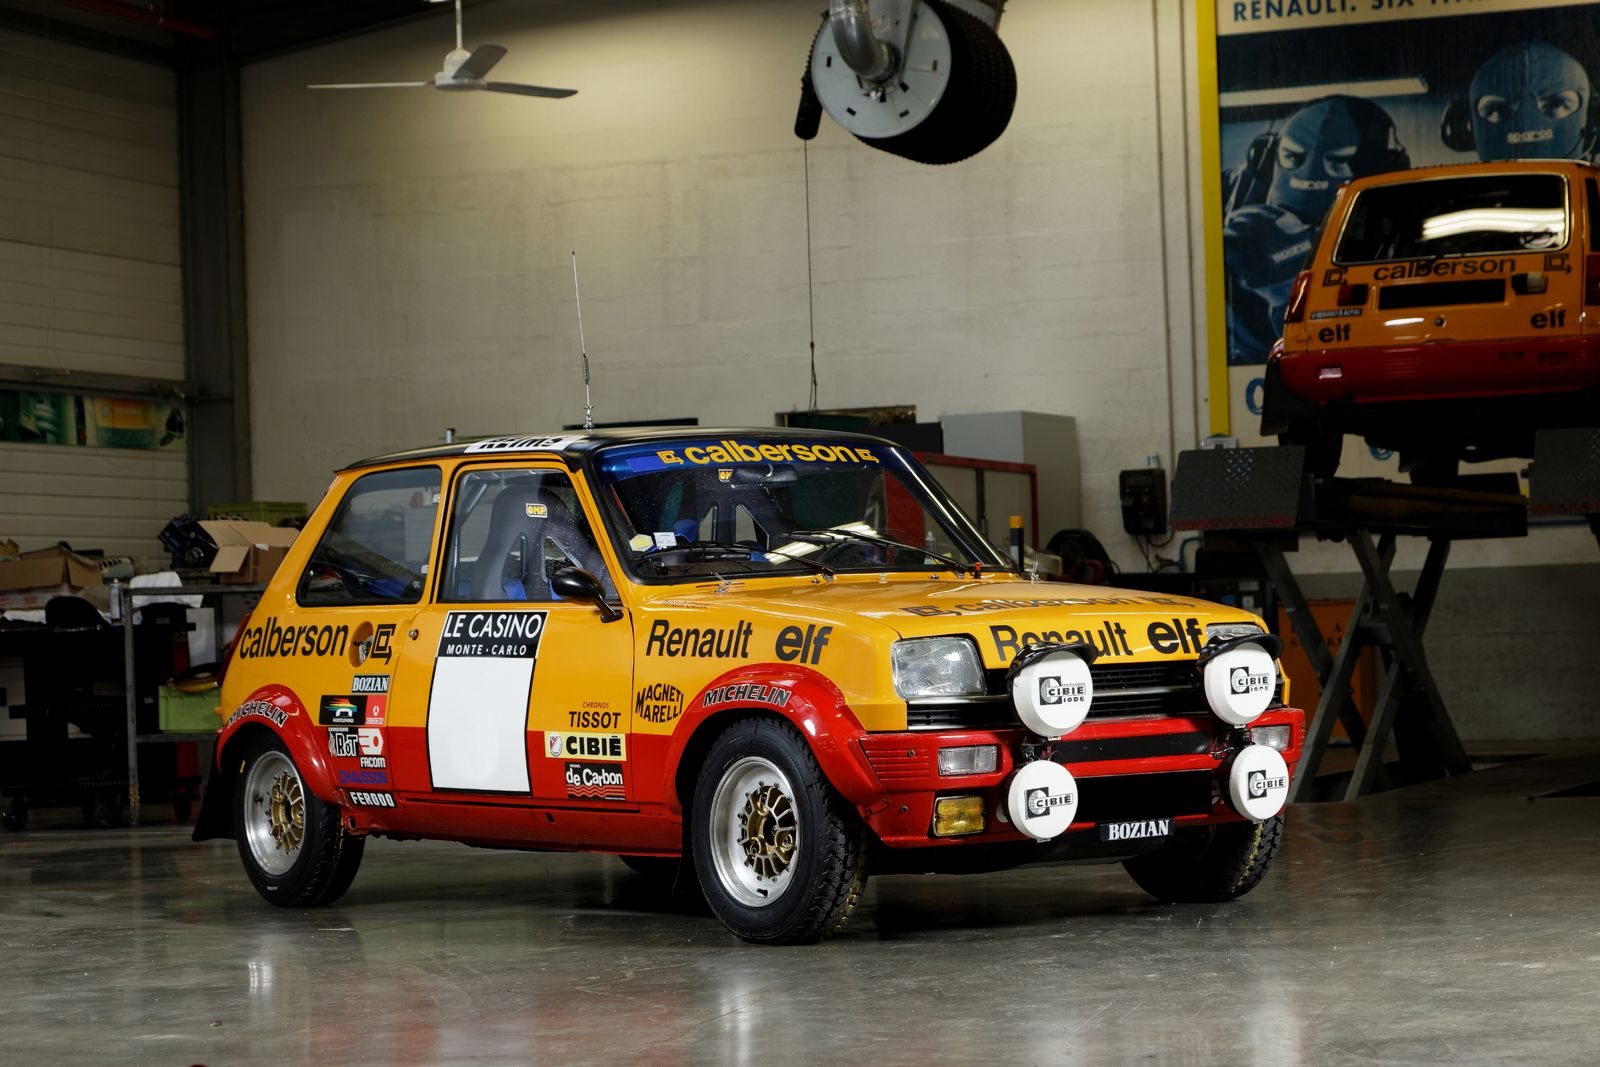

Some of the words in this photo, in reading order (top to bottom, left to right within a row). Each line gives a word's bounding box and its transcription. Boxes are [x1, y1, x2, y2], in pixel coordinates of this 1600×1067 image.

[1373, 255, 1517, 282] calberson
[1530, 310, 1567, 329] elf
[1318, 324, 1352, 343] elf
[684, 440, 862, 464] calberson
[239, 616, 349, 659] calberson
[443, 614, 466, 638] LE
[468, 614, 542, 638] CASINO
[1147, 617, 1203, 655] elf
[446, 644, 483, 655] MONTE
[491, 645, 527, 656] CARLO
[646, 619, 753, 659] Renault
[775, 624, 834, 665] elf
[351, 677, 389, 692] BOZIAN
[635, 683, 684, 709] MAGNETI
[703, 683, 792, 708] MICHELIN
[227, 700, 289, 730] MICHELIN
[582, 701, 609, 709] CHRONOS
[635, 699, 684, 723] MARELLI
[569, 711, 621, 729] TISSOT
[360, 757, 386, 769] FACOM
[566, 768, 581, 787] de
[582, 768, 624, 787] Carbon
[349, 791, 396, 808] FERODO
[1108, 819, 1170, 841] BOZIAN
